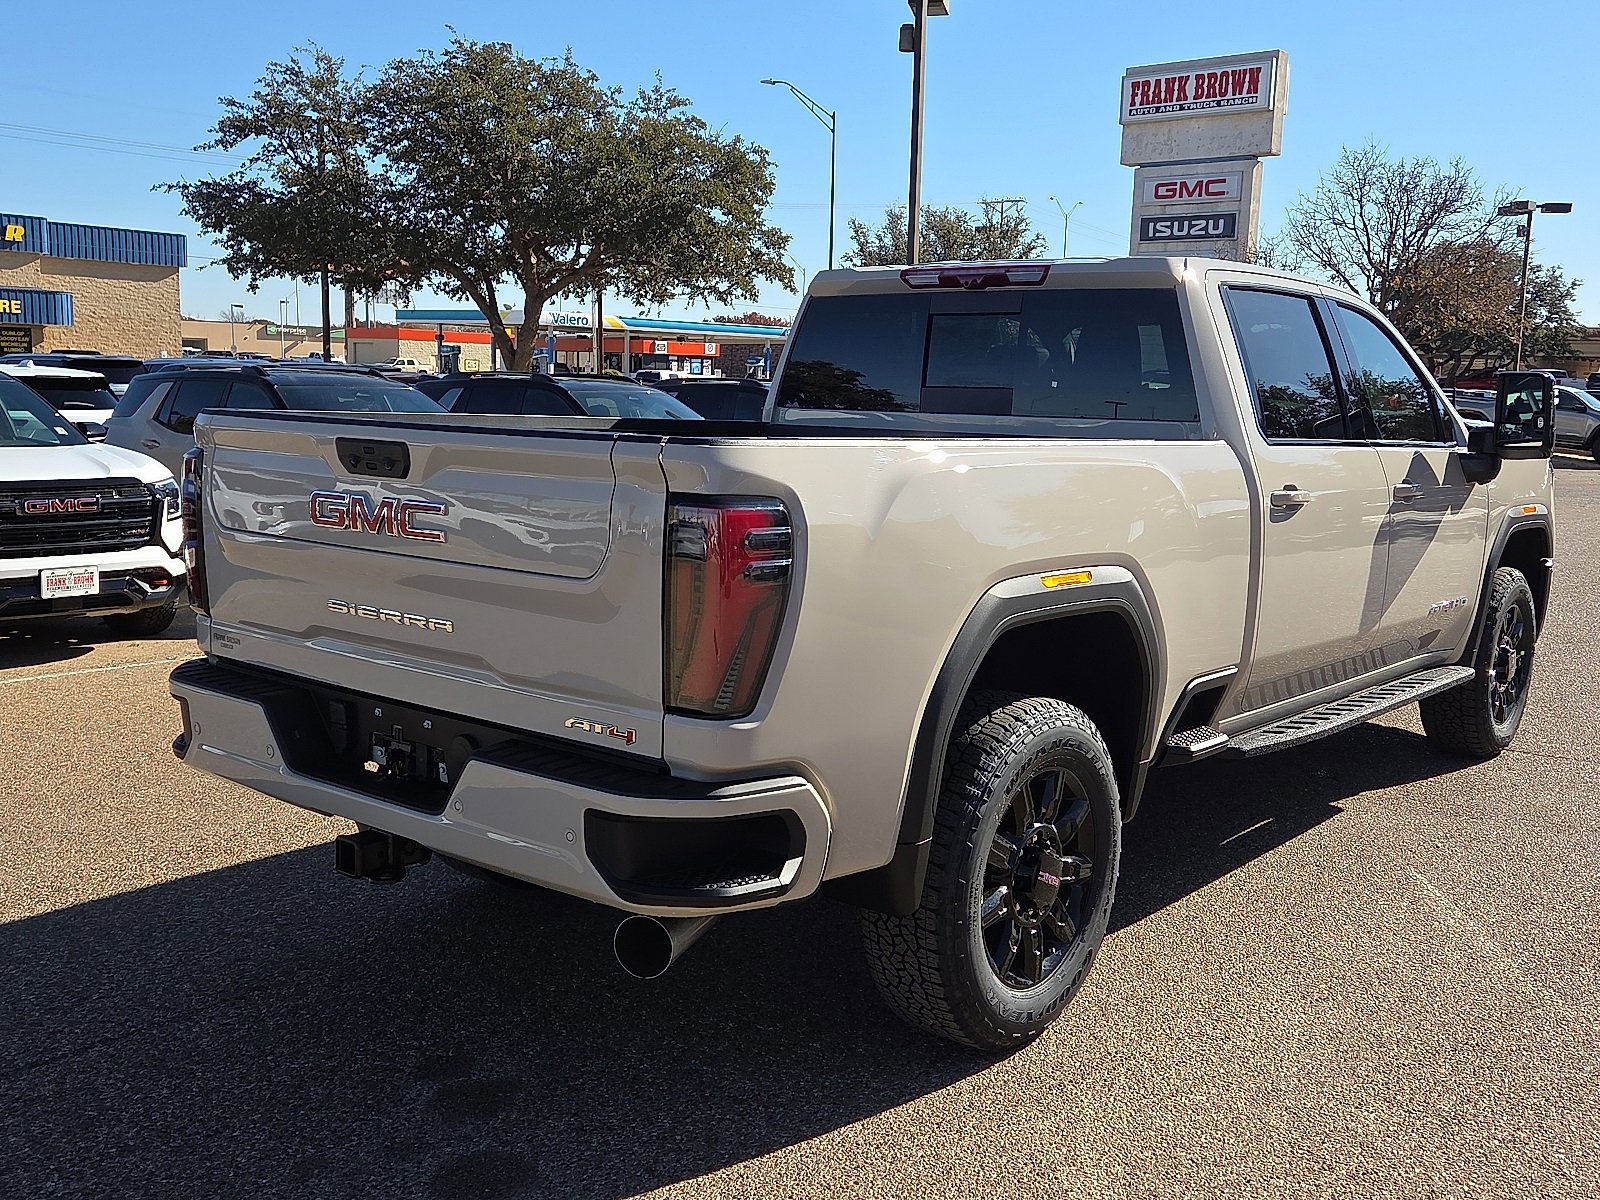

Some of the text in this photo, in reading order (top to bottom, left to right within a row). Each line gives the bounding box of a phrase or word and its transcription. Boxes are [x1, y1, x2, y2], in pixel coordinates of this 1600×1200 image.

[1130, 67, 1262, 107] FRANK BROWN
[1130, 97, 1257, 116] AUTO AND TRUCK RANCH
[1154, 178, 1228, 200] GMC
[1148, 218, 1225, 238] ISUZU
[550, 312, 589, 326] Valero
[24, 497, 98, 514] GMC
[309, 489, 449, 543] GMC
[46, 577, 67, 588] FRANK
[73, 575, 95, 585] BROWN
[326, 598, 455, 634] SIERRA
[564, 716, 637, 746] AT4
